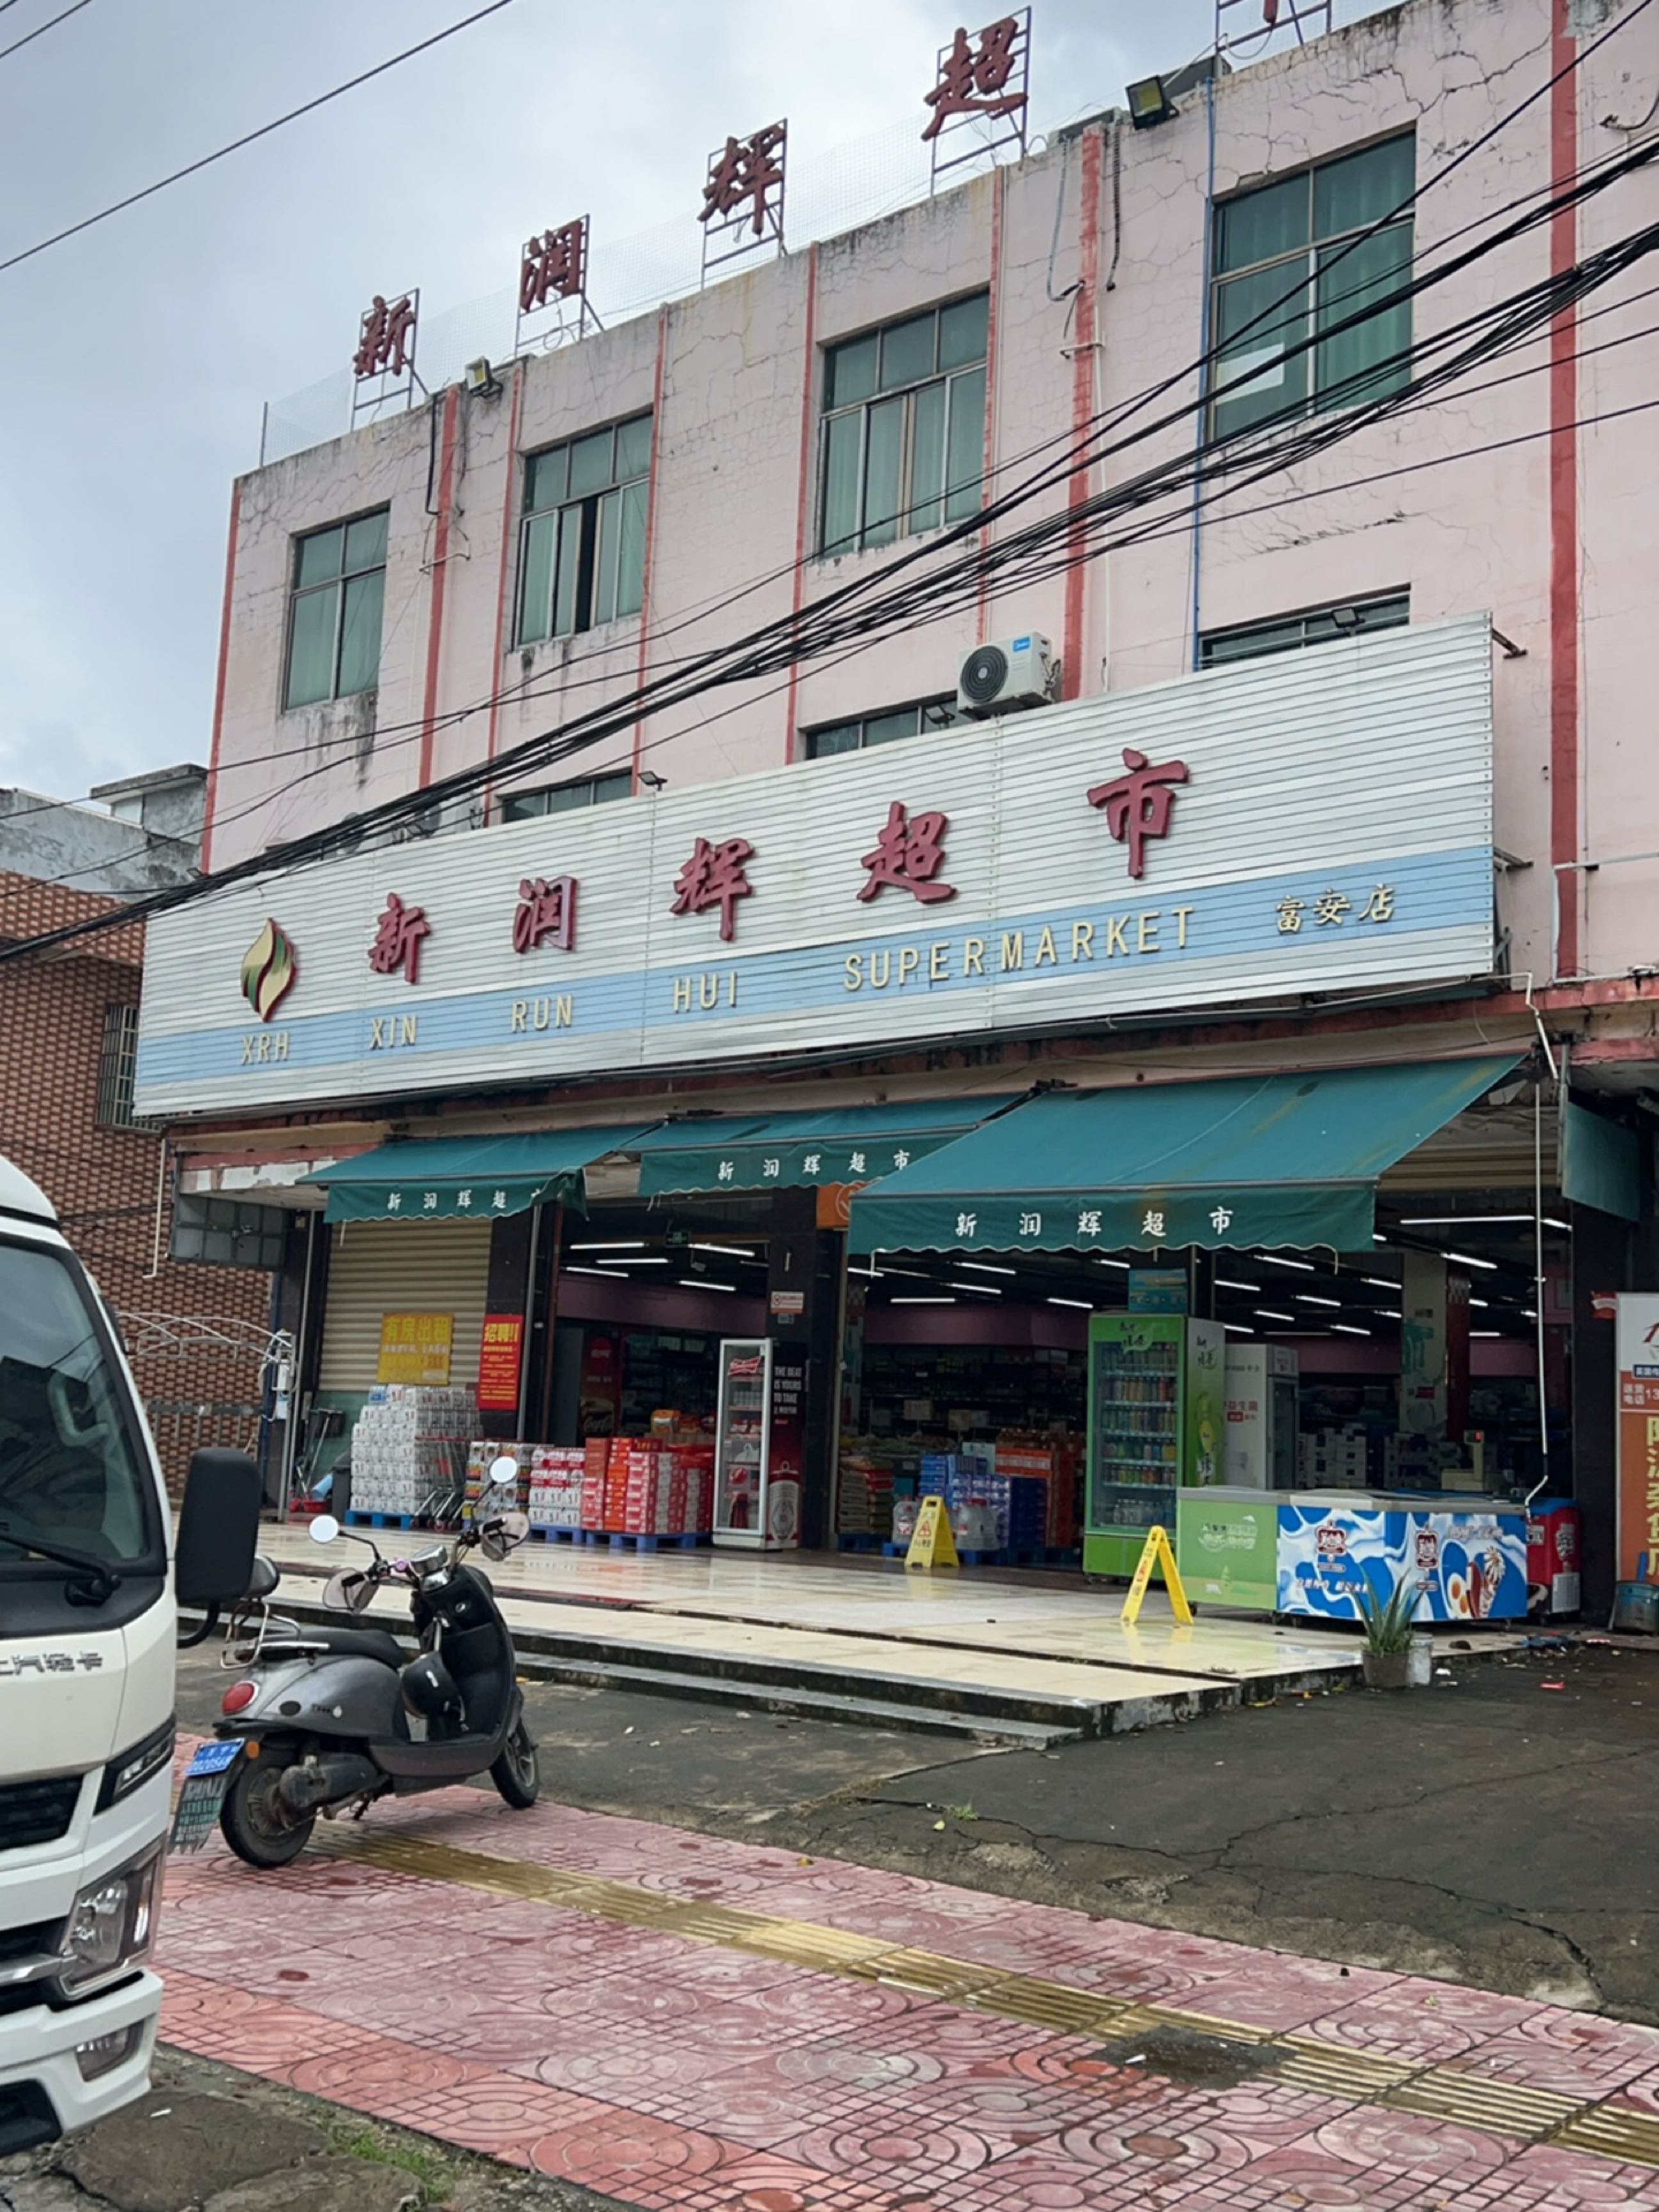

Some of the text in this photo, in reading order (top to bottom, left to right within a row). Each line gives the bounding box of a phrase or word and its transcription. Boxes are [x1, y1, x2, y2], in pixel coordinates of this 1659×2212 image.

[367, 748, 1189, 985] 新润辉超市
[1276, 883, 1395, 935] 富安店
[369, 907, 1194, 1051] XIN RUN HUI SUPERMARKET
[241, 1031, 291, 1066] XRH
[717, 1150, 911, 1181] 新润辉超市
[954, 1206, 1234, 1238] 新润辉超市
[385, 1316, 449, 1343] 有房出租
